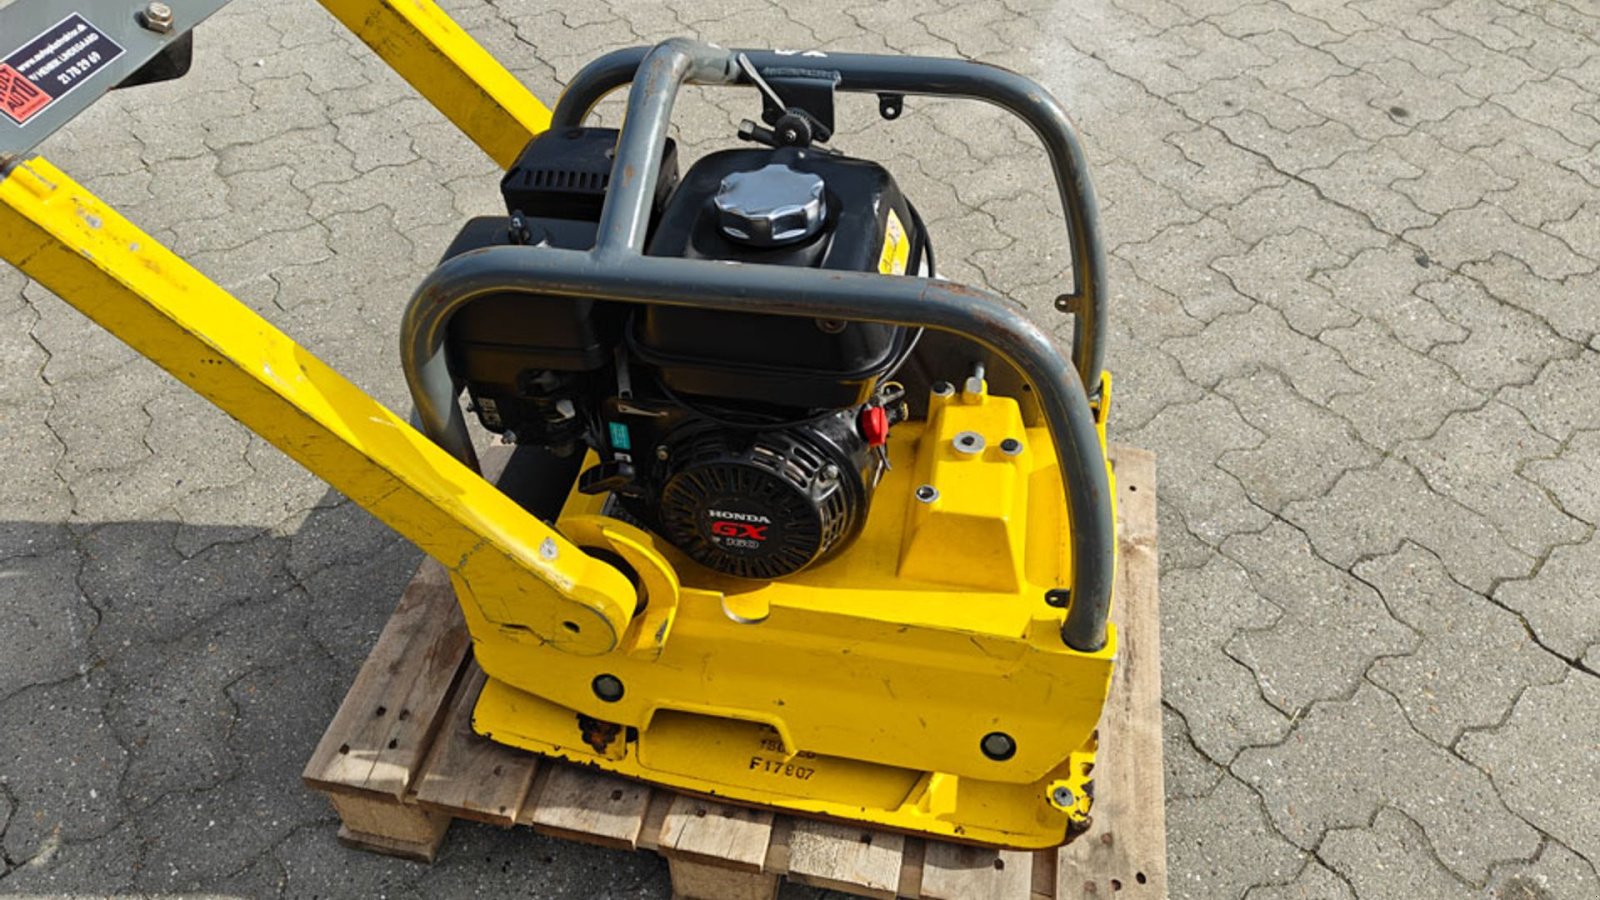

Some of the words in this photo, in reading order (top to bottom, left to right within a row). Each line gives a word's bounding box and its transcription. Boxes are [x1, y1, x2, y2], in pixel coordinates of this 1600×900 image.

[57, 73, 71, 85] 21
[66, 66, 82, 78] 78
[76, 58, 91, 71] 29
[7, 77, 39, 112] AUTO
[708, 509, 772, 524] HONDA
[712, 521, 768, 541] GX
[726, 537, 760, 549] 160
